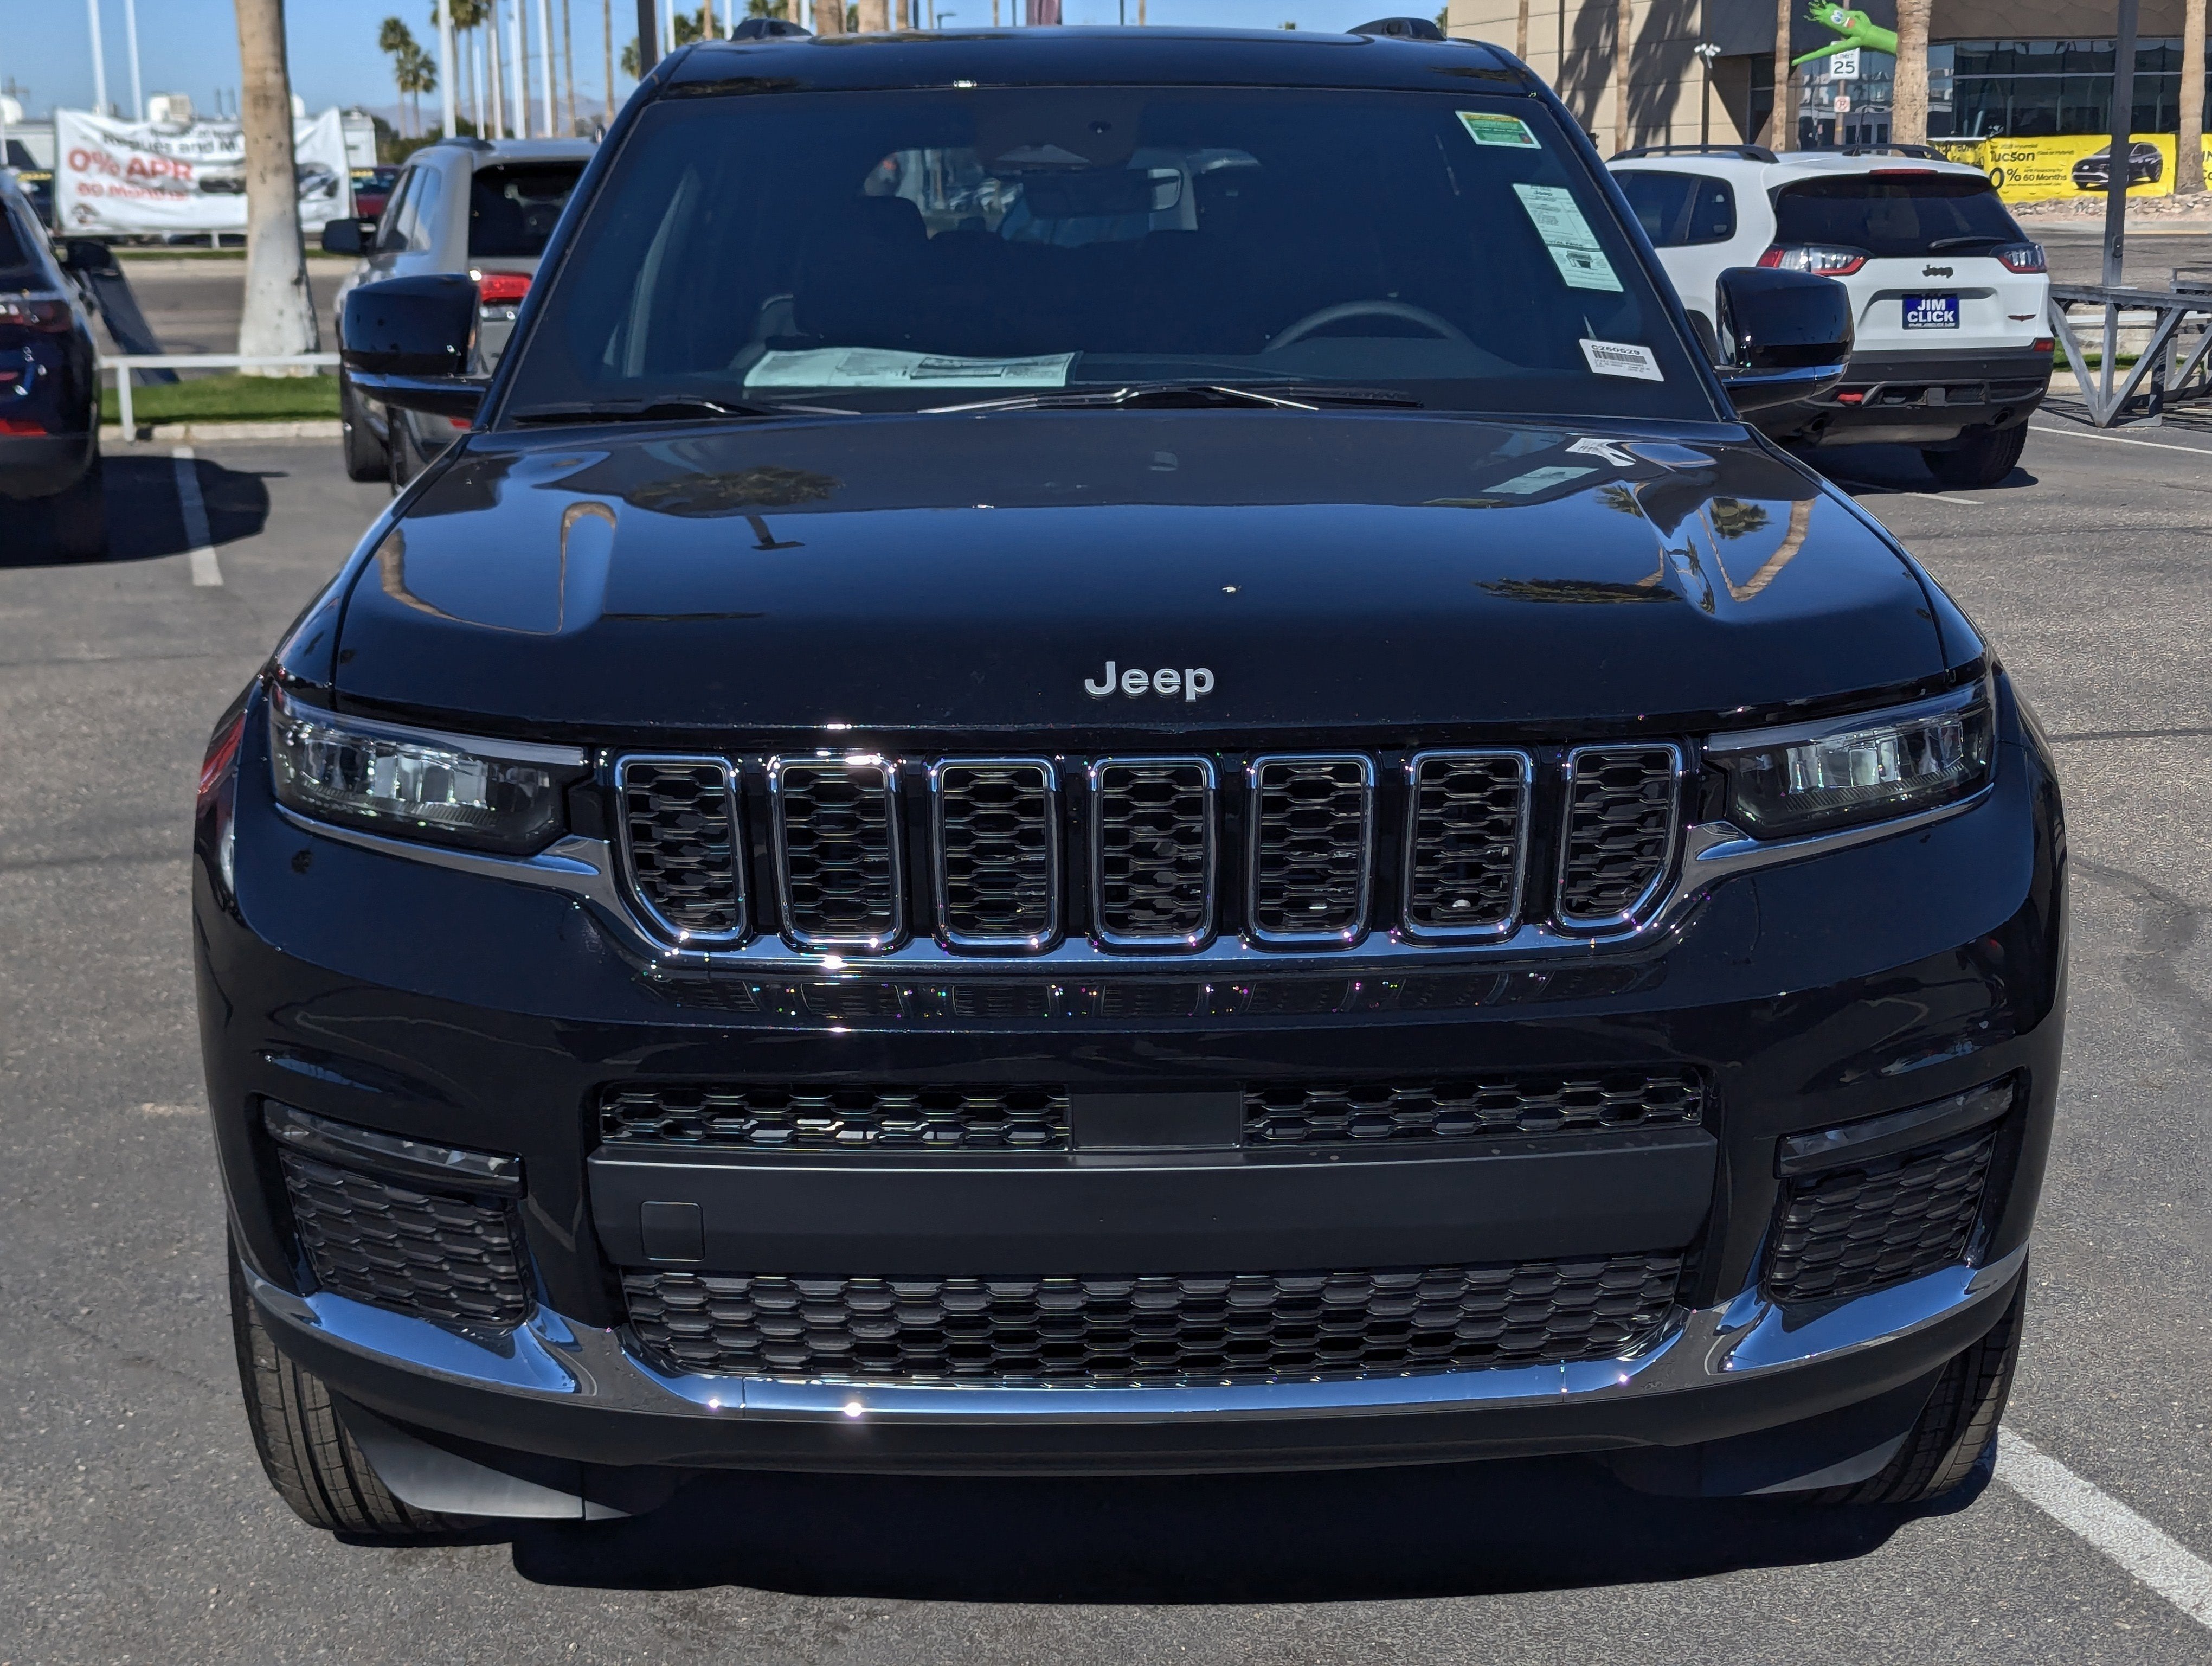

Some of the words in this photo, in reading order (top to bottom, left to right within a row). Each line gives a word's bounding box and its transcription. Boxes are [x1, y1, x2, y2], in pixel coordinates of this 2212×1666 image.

[1834, 61, 1855, 74] 25
[1990, 151, 2035, 162] Tucson
[126, 156, 194, 181] APR
[1917, 299, 1946, 311] JIM
[1907, 311, 1954, 322] CLICK
[1084, 661, 1214, 702] Jeep
